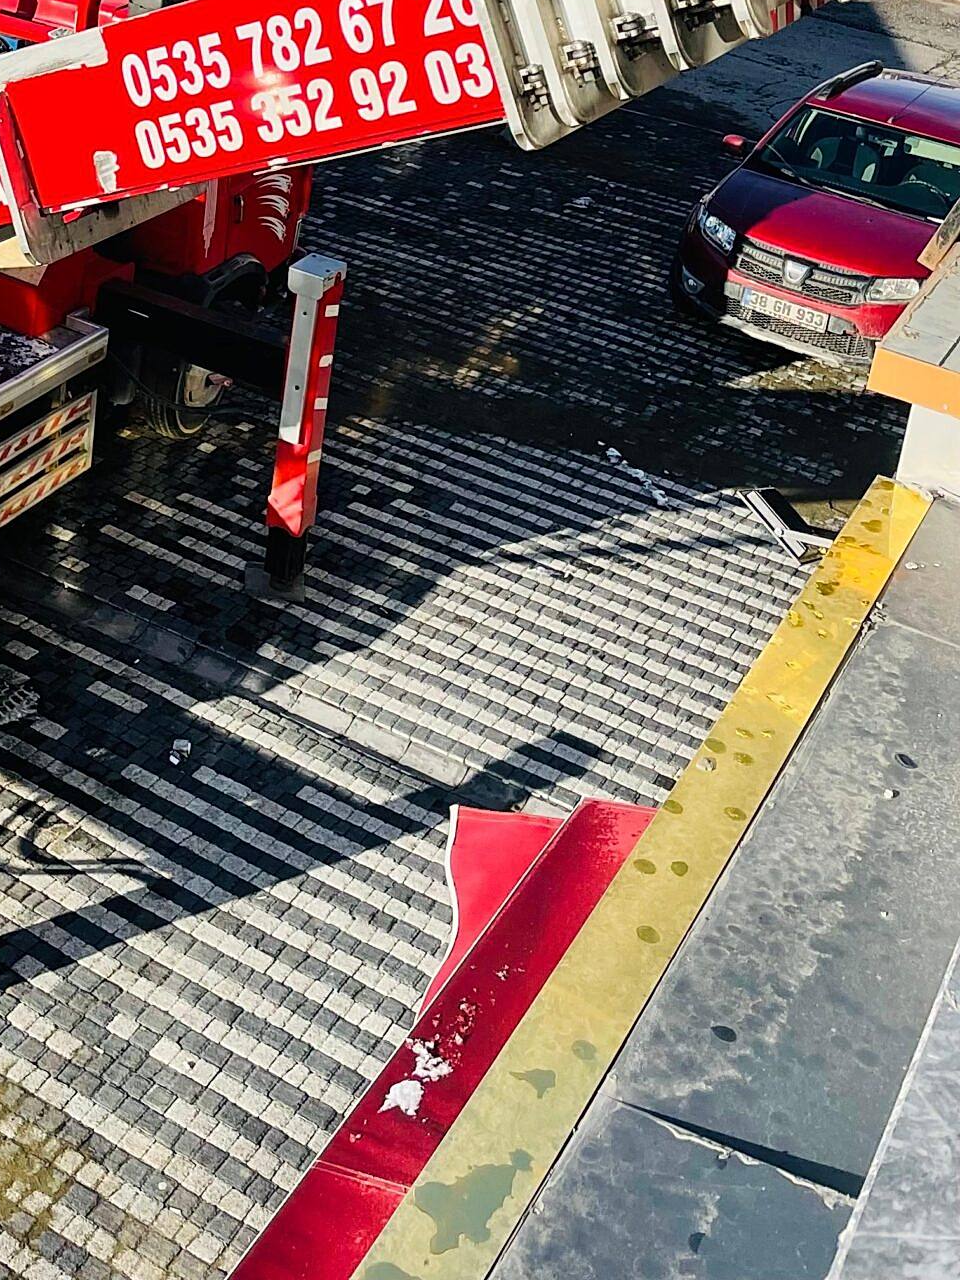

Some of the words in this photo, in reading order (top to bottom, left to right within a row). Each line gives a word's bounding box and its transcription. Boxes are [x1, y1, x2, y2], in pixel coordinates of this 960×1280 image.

[121, 32, 231, 108] 0535
[237, 7, 333, 79] 782
[134, 100, 244, 169] 0535
[250, 78, 342, 143] 352
[349, 60, 418, 121] 92
[424, 42, 494, 105] 03
[751, 293, 768, 308] 38
[796, 306, 825, 327] 933
